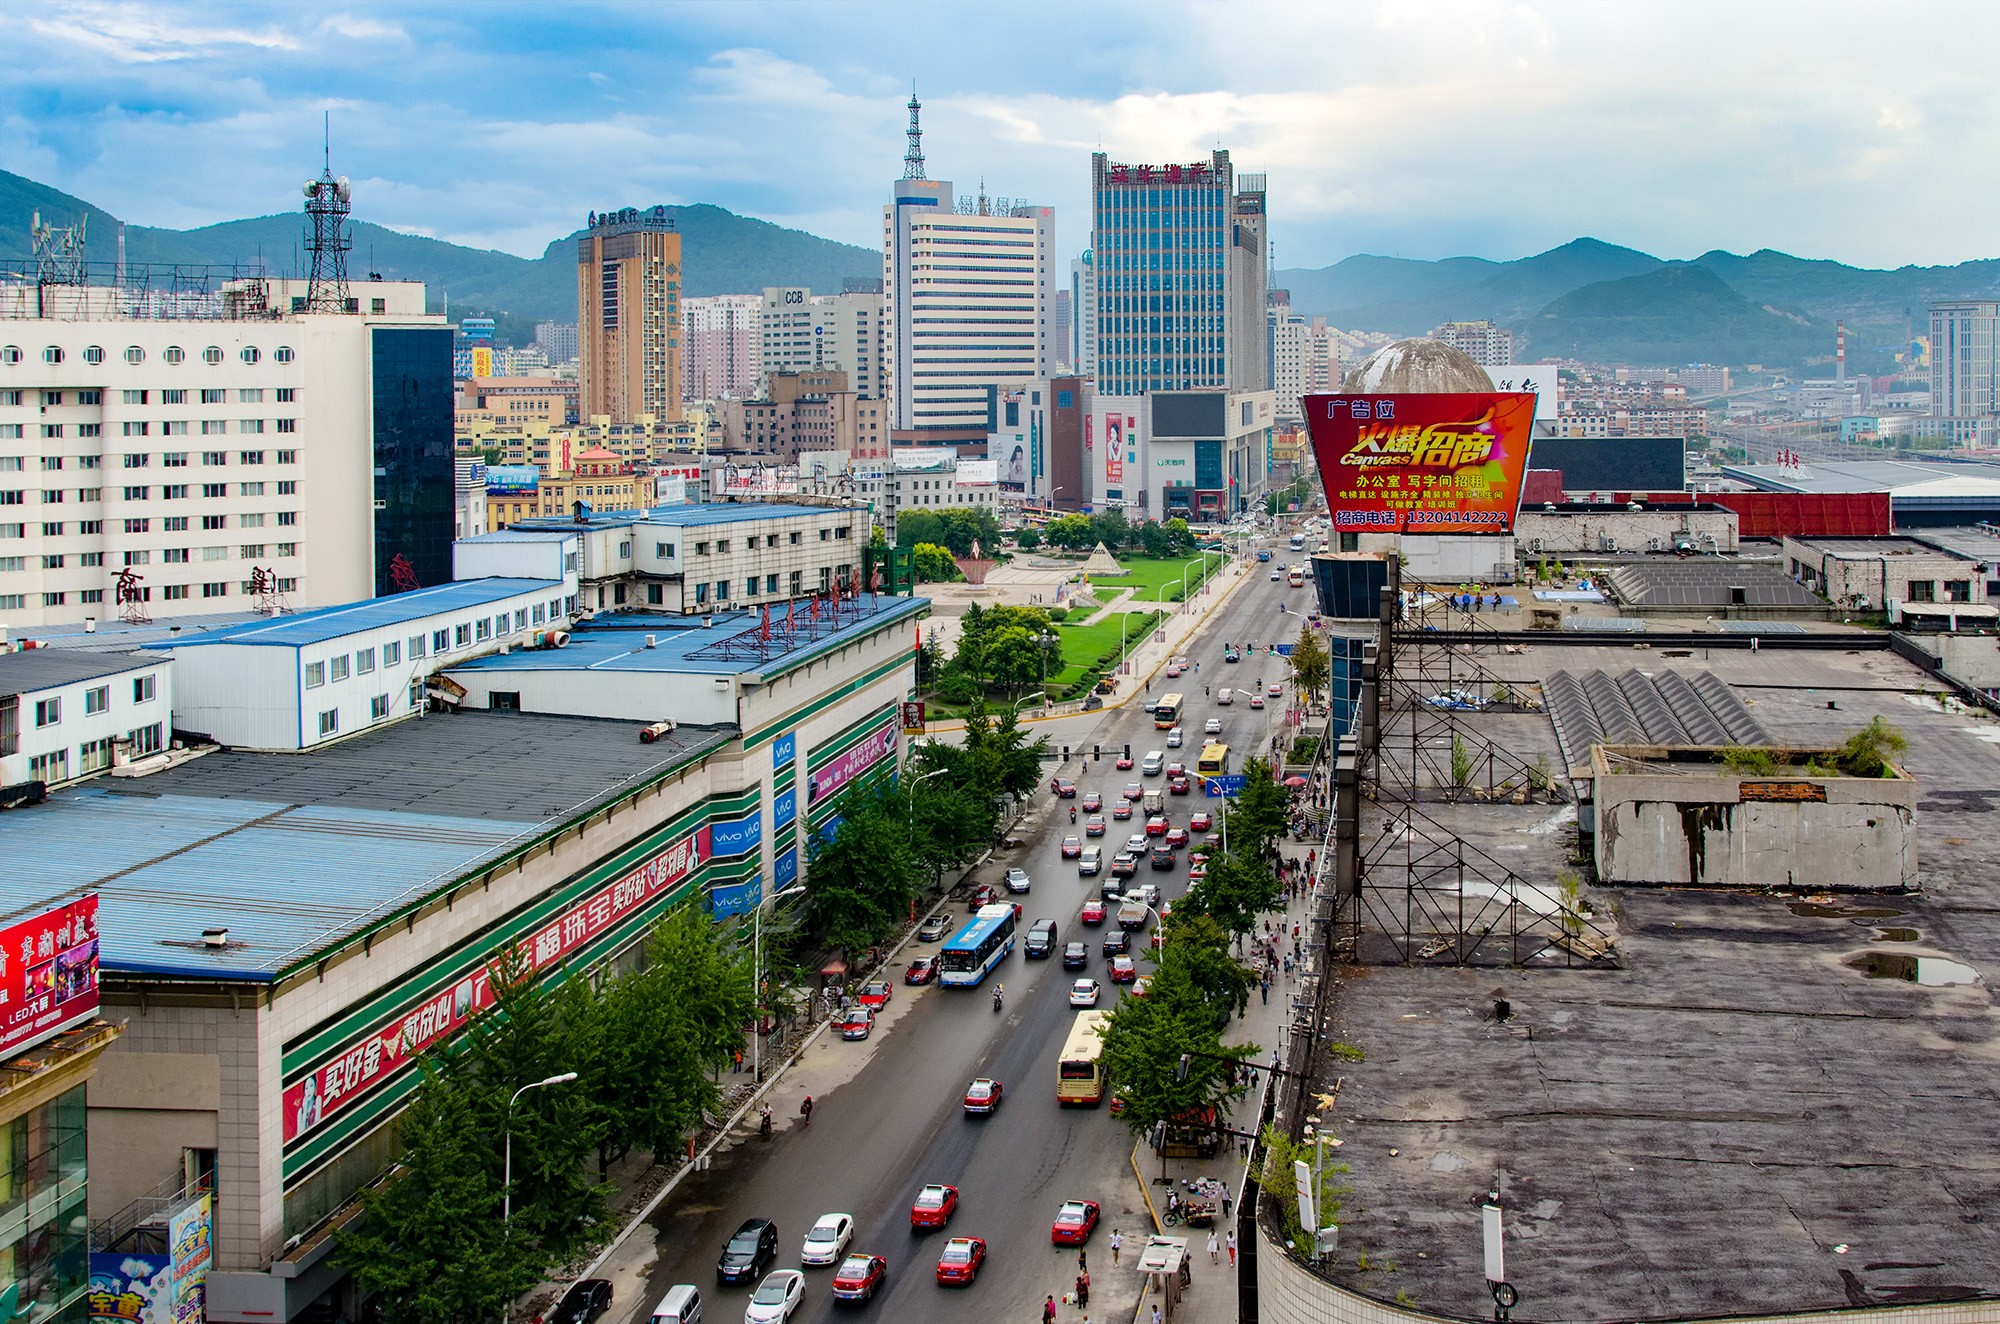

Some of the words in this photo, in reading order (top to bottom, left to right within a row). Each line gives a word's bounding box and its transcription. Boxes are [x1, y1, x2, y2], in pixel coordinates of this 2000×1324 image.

[785, 291, 803, 304] CCB
[1328, 400, 1395, 418] 广告位
[1350, 418, 1496, 468] 火爆招商
[1340, 452, 1411, 466] Canvass
[1356, 474, 1401, 488] 办公室
[1408, 475, 1484, 488] 写字间招租
[1339, 490, 1377, 499] 电梯直达
[1381, 490, 1419, 499] 设施齐全
[1422, 490, 1451, 499] 精装修
[1455, 490, 1504, 500] 独立卫生间
[1427, 500, 1457, 509] 培训班
[776, 742, 791, 758] vivo
[777, 799, 792, 816] vivo
[744, 821, 760, 838] vivo
[715, 833, 742, 844] vivo
[777, 859, 792, 876] vivo
[323, 1036, 383, 1109] 买好金
[400, 994, 453, 1056] 戴放心
[612, 870, 648, 915] 买好钻
[656, 843, 689, 887] 超划算
[9, 996, 49, 1025] LED大屏
